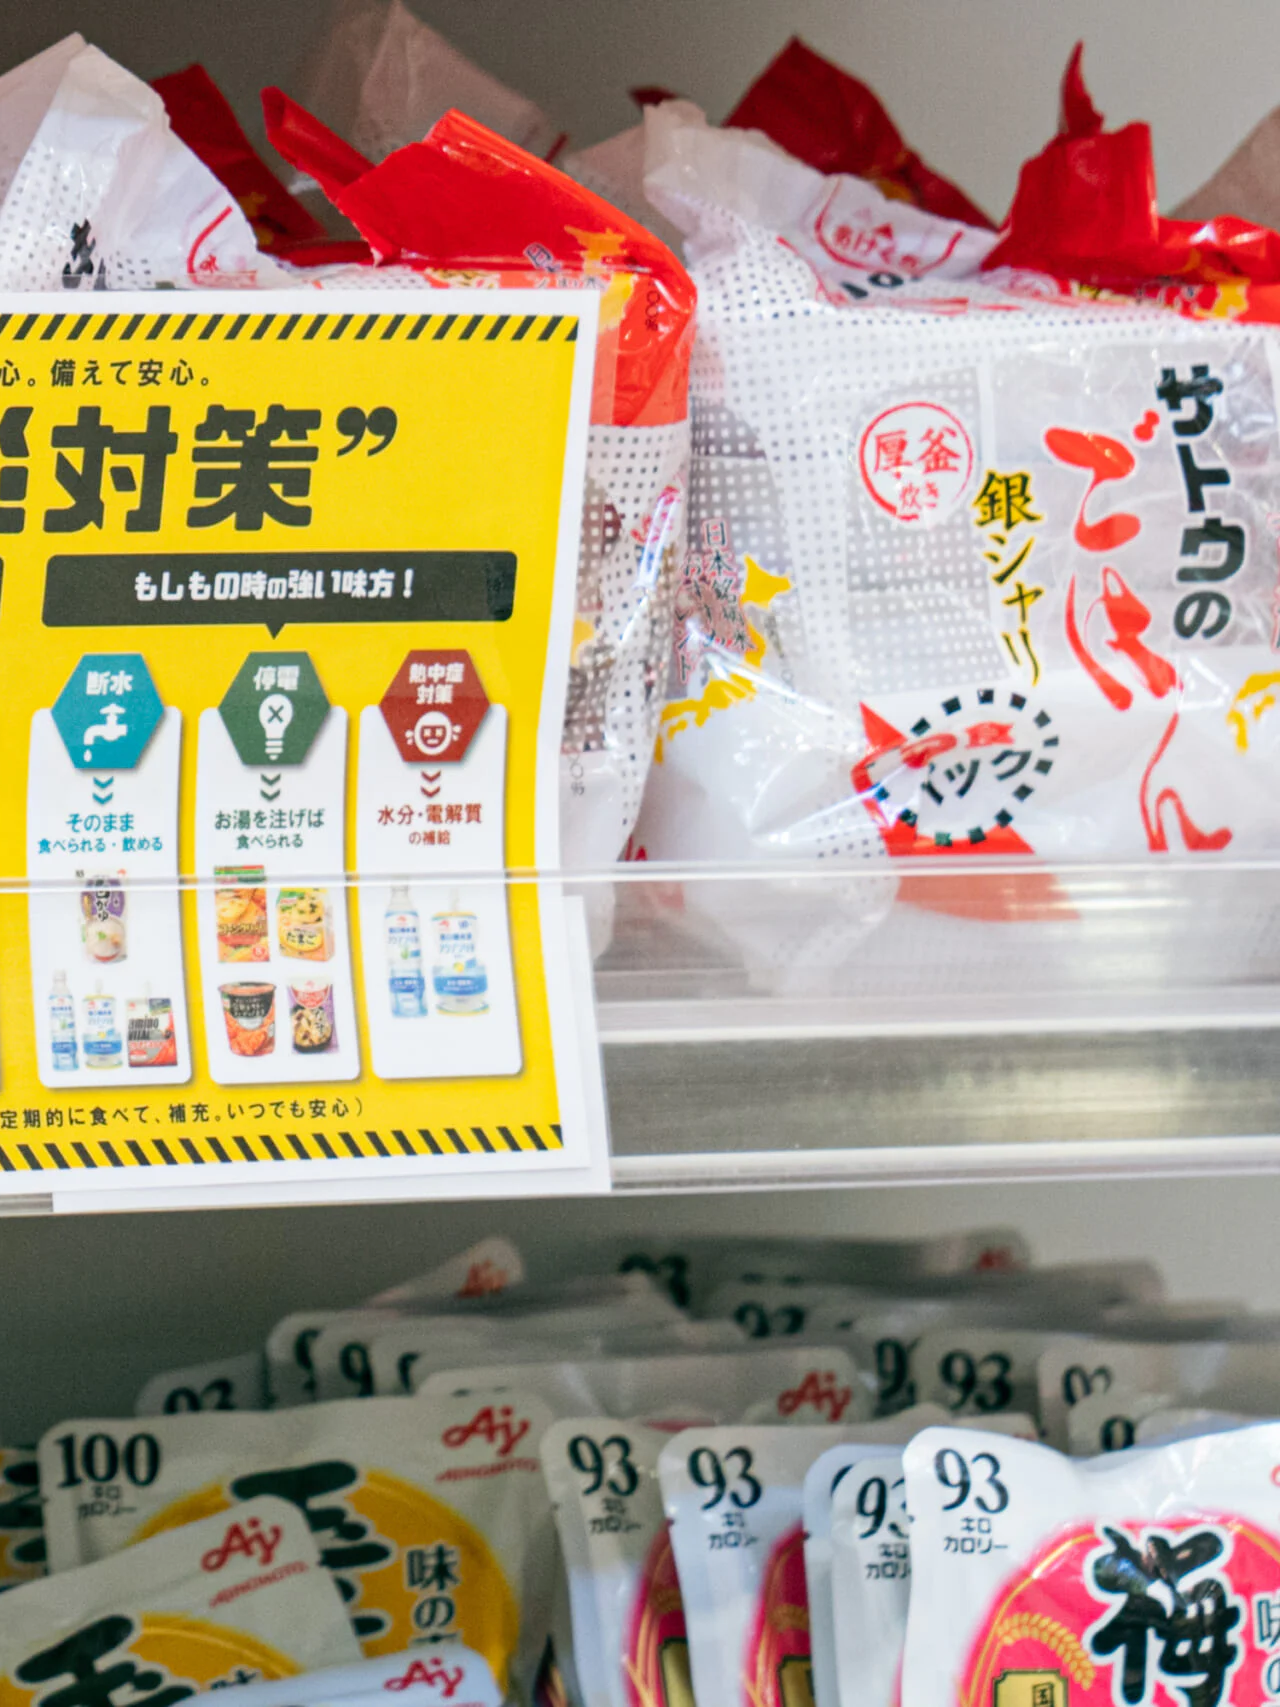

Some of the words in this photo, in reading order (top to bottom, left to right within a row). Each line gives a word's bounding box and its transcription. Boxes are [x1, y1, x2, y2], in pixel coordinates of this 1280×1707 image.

[872, 425, 963, 477] 厚釜
[1156, 364, 1246, 640] サトウの
[134, 568, 414, 602] もしもの時の強い味方!
[973, 469, 1043, 686] 銀シャリ
[1043, 410, 1233, 853] ごはん
[86, 670, 133, 697] 断水
[253, 664, 300, 692] 停電
[408, 662, 464, 684] 熱中症
[416, 685, 454, 704] 対策
[65, 812, 136, 833] そのまま
[214, 807, 325, 831] お湯を注げば
[376, 803, 483, 826] 水分・電解質
[37, 836, 164, 854] 食べられる・飲める
[235, 834, 304, 850] 食べられる
[407, 830, 451, 846] の補給
[939, 1348, 1013, 1412] 93
[55, 1432, 161, 1489] 100
[568, 1435, 639, 1497] 93
[688, 1446, 762, 1510] 93
[934, 1448, 1010, 1514] 93
[959, 1517, 993, 1533] キロ
[943, 1536, 1009, 1554] カロリー
[1090, 1526, 1243, 1707] 梅
